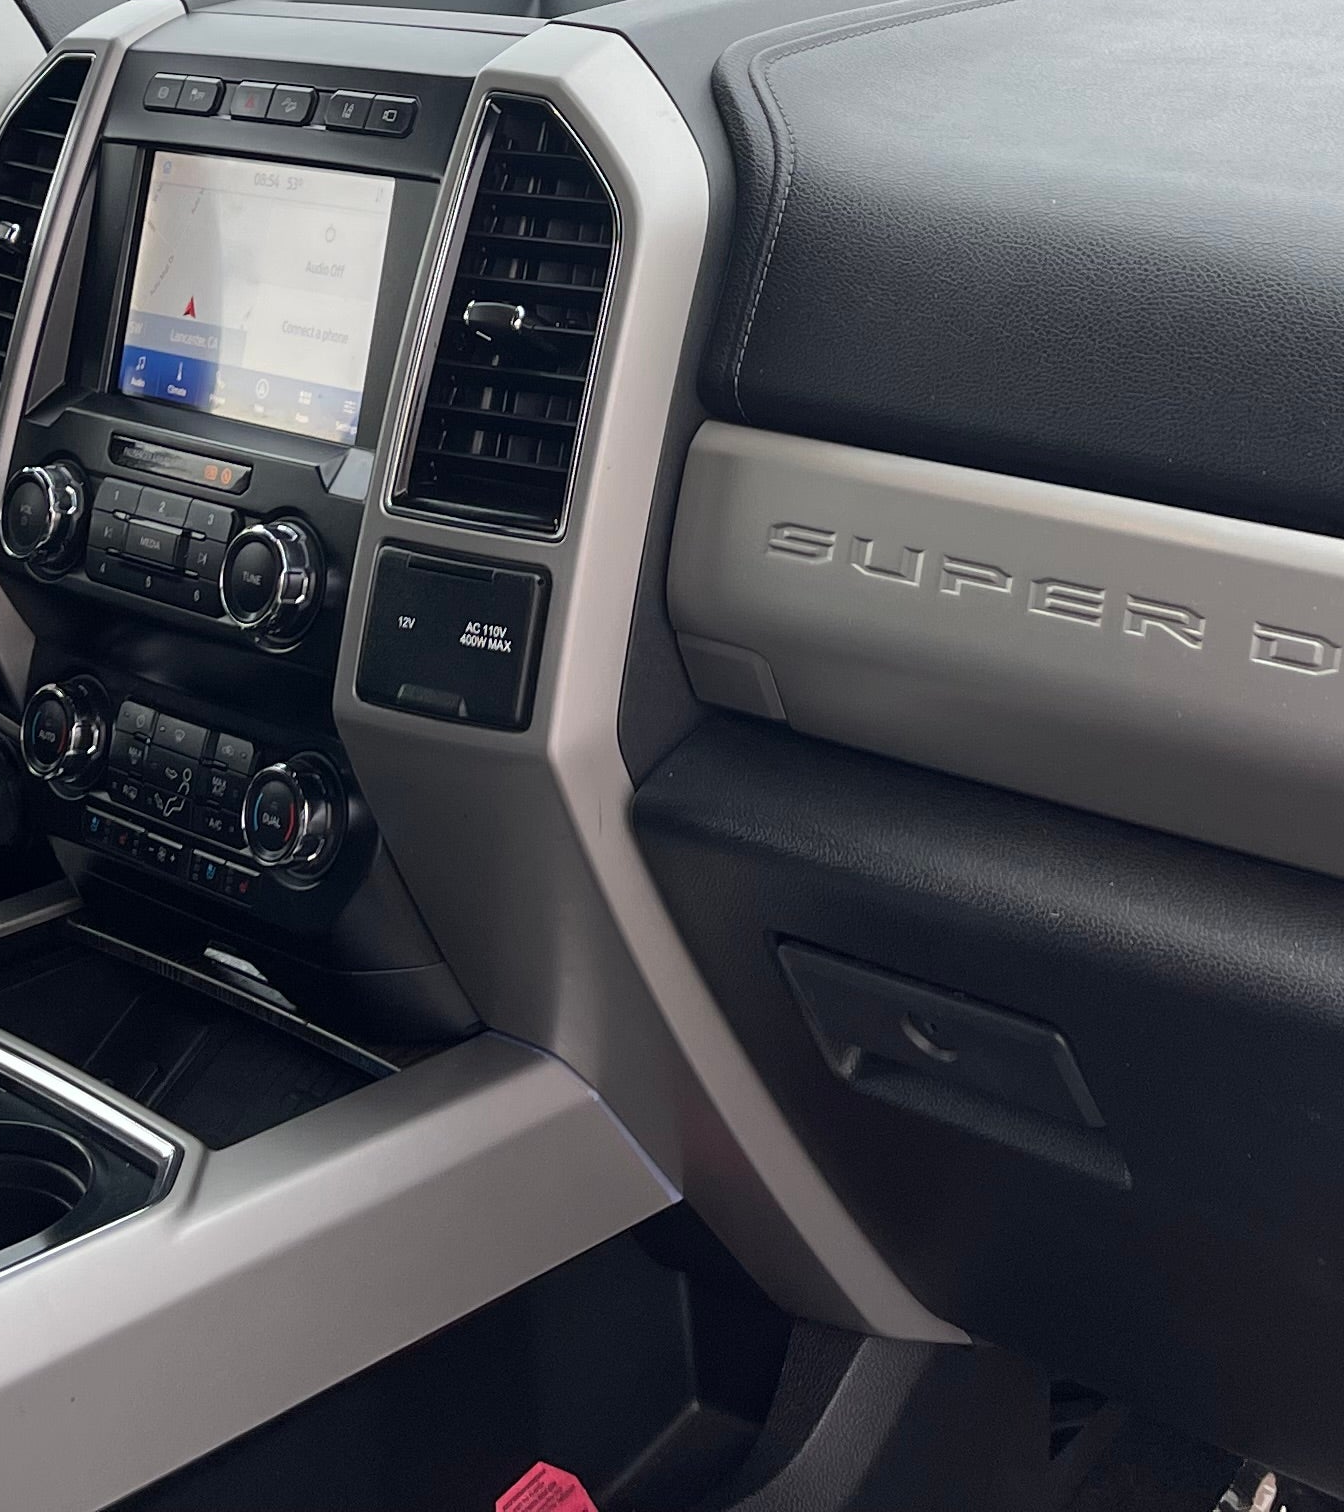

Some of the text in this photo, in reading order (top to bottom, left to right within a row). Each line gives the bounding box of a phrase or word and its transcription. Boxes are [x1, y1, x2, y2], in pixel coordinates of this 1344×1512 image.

[158, 501, 167, 513] 2
[207, 514, 215, 526] 3
[139, 536, 161, 550] MEDIA
[767, 520, 1207, 651] SUPER
[397, 615, 416, 629] 12V
[464, 621, 508, 639] AC 110V
[459, 633, 512, 654] 400W MAX
